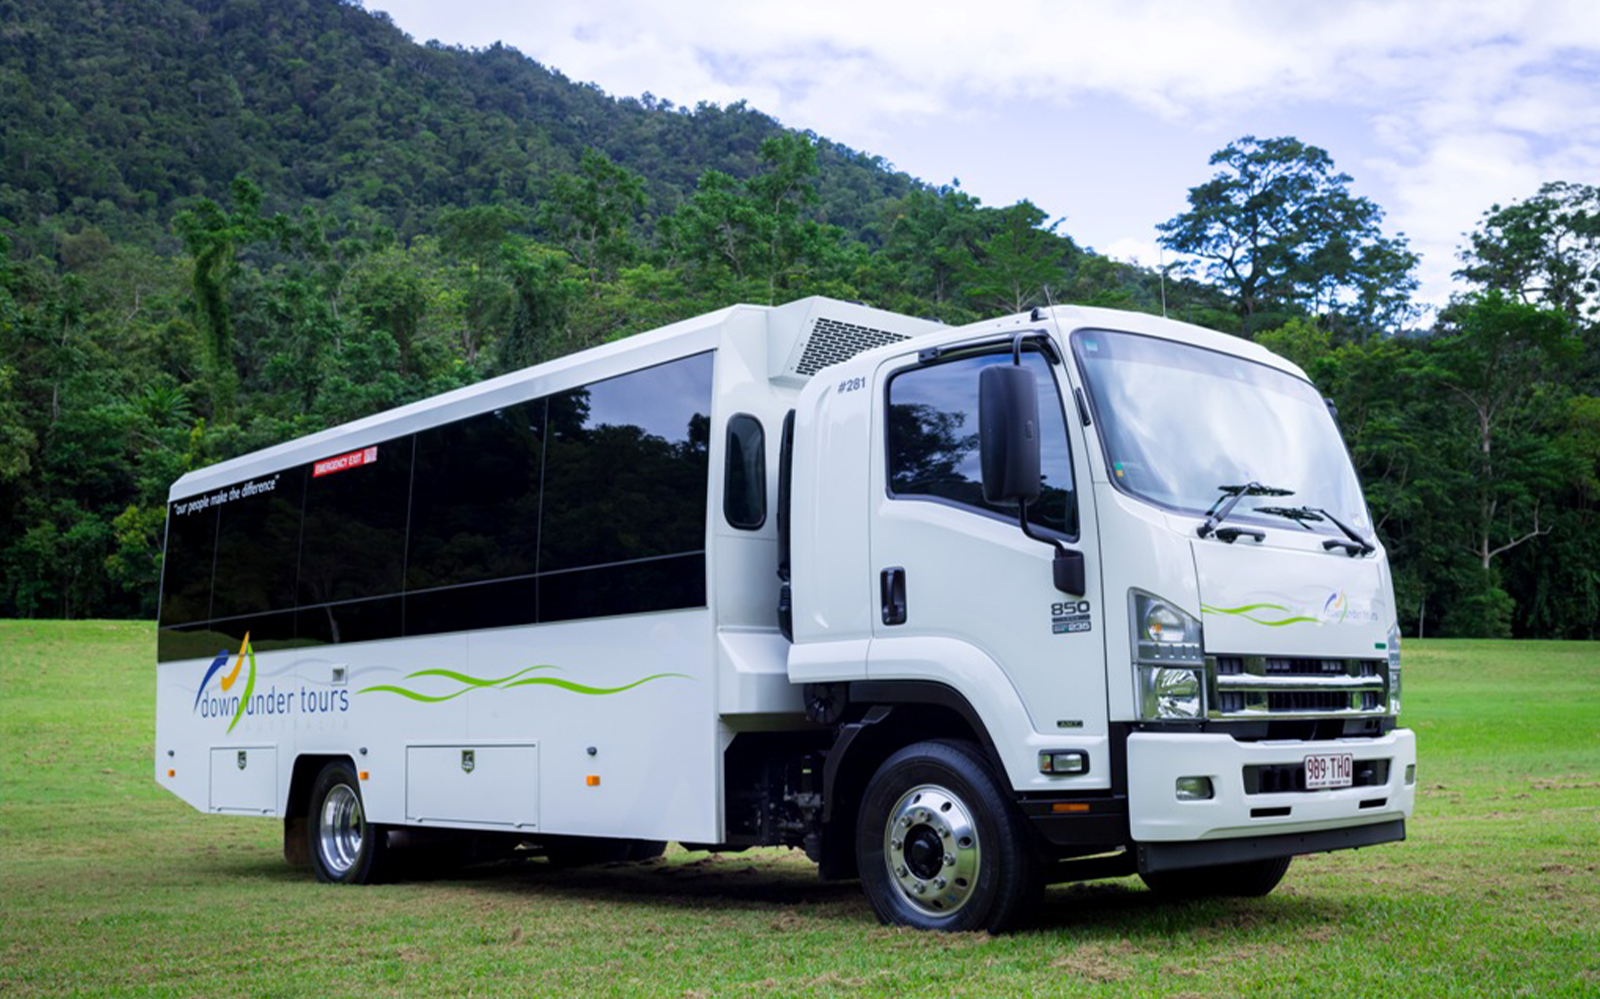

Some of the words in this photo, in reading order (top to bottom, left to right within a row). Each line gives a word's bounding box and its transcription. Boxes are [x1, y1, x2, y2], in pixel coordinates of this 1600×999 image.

[837, 376, 866, 394] #281
[315, 458, 347, 475] EMERGENCY
[348, 452, 363, 467] EXIT
[188, 494, 210, 516] people
[210, 489, 228, 506] make
[229, 486, 241, 501] the
[1051, 600, 1091, 616] 850
[202, 691, 239, 718] down
[245, 685, 295, 716] under
[301, 686, 350, 713] tours
